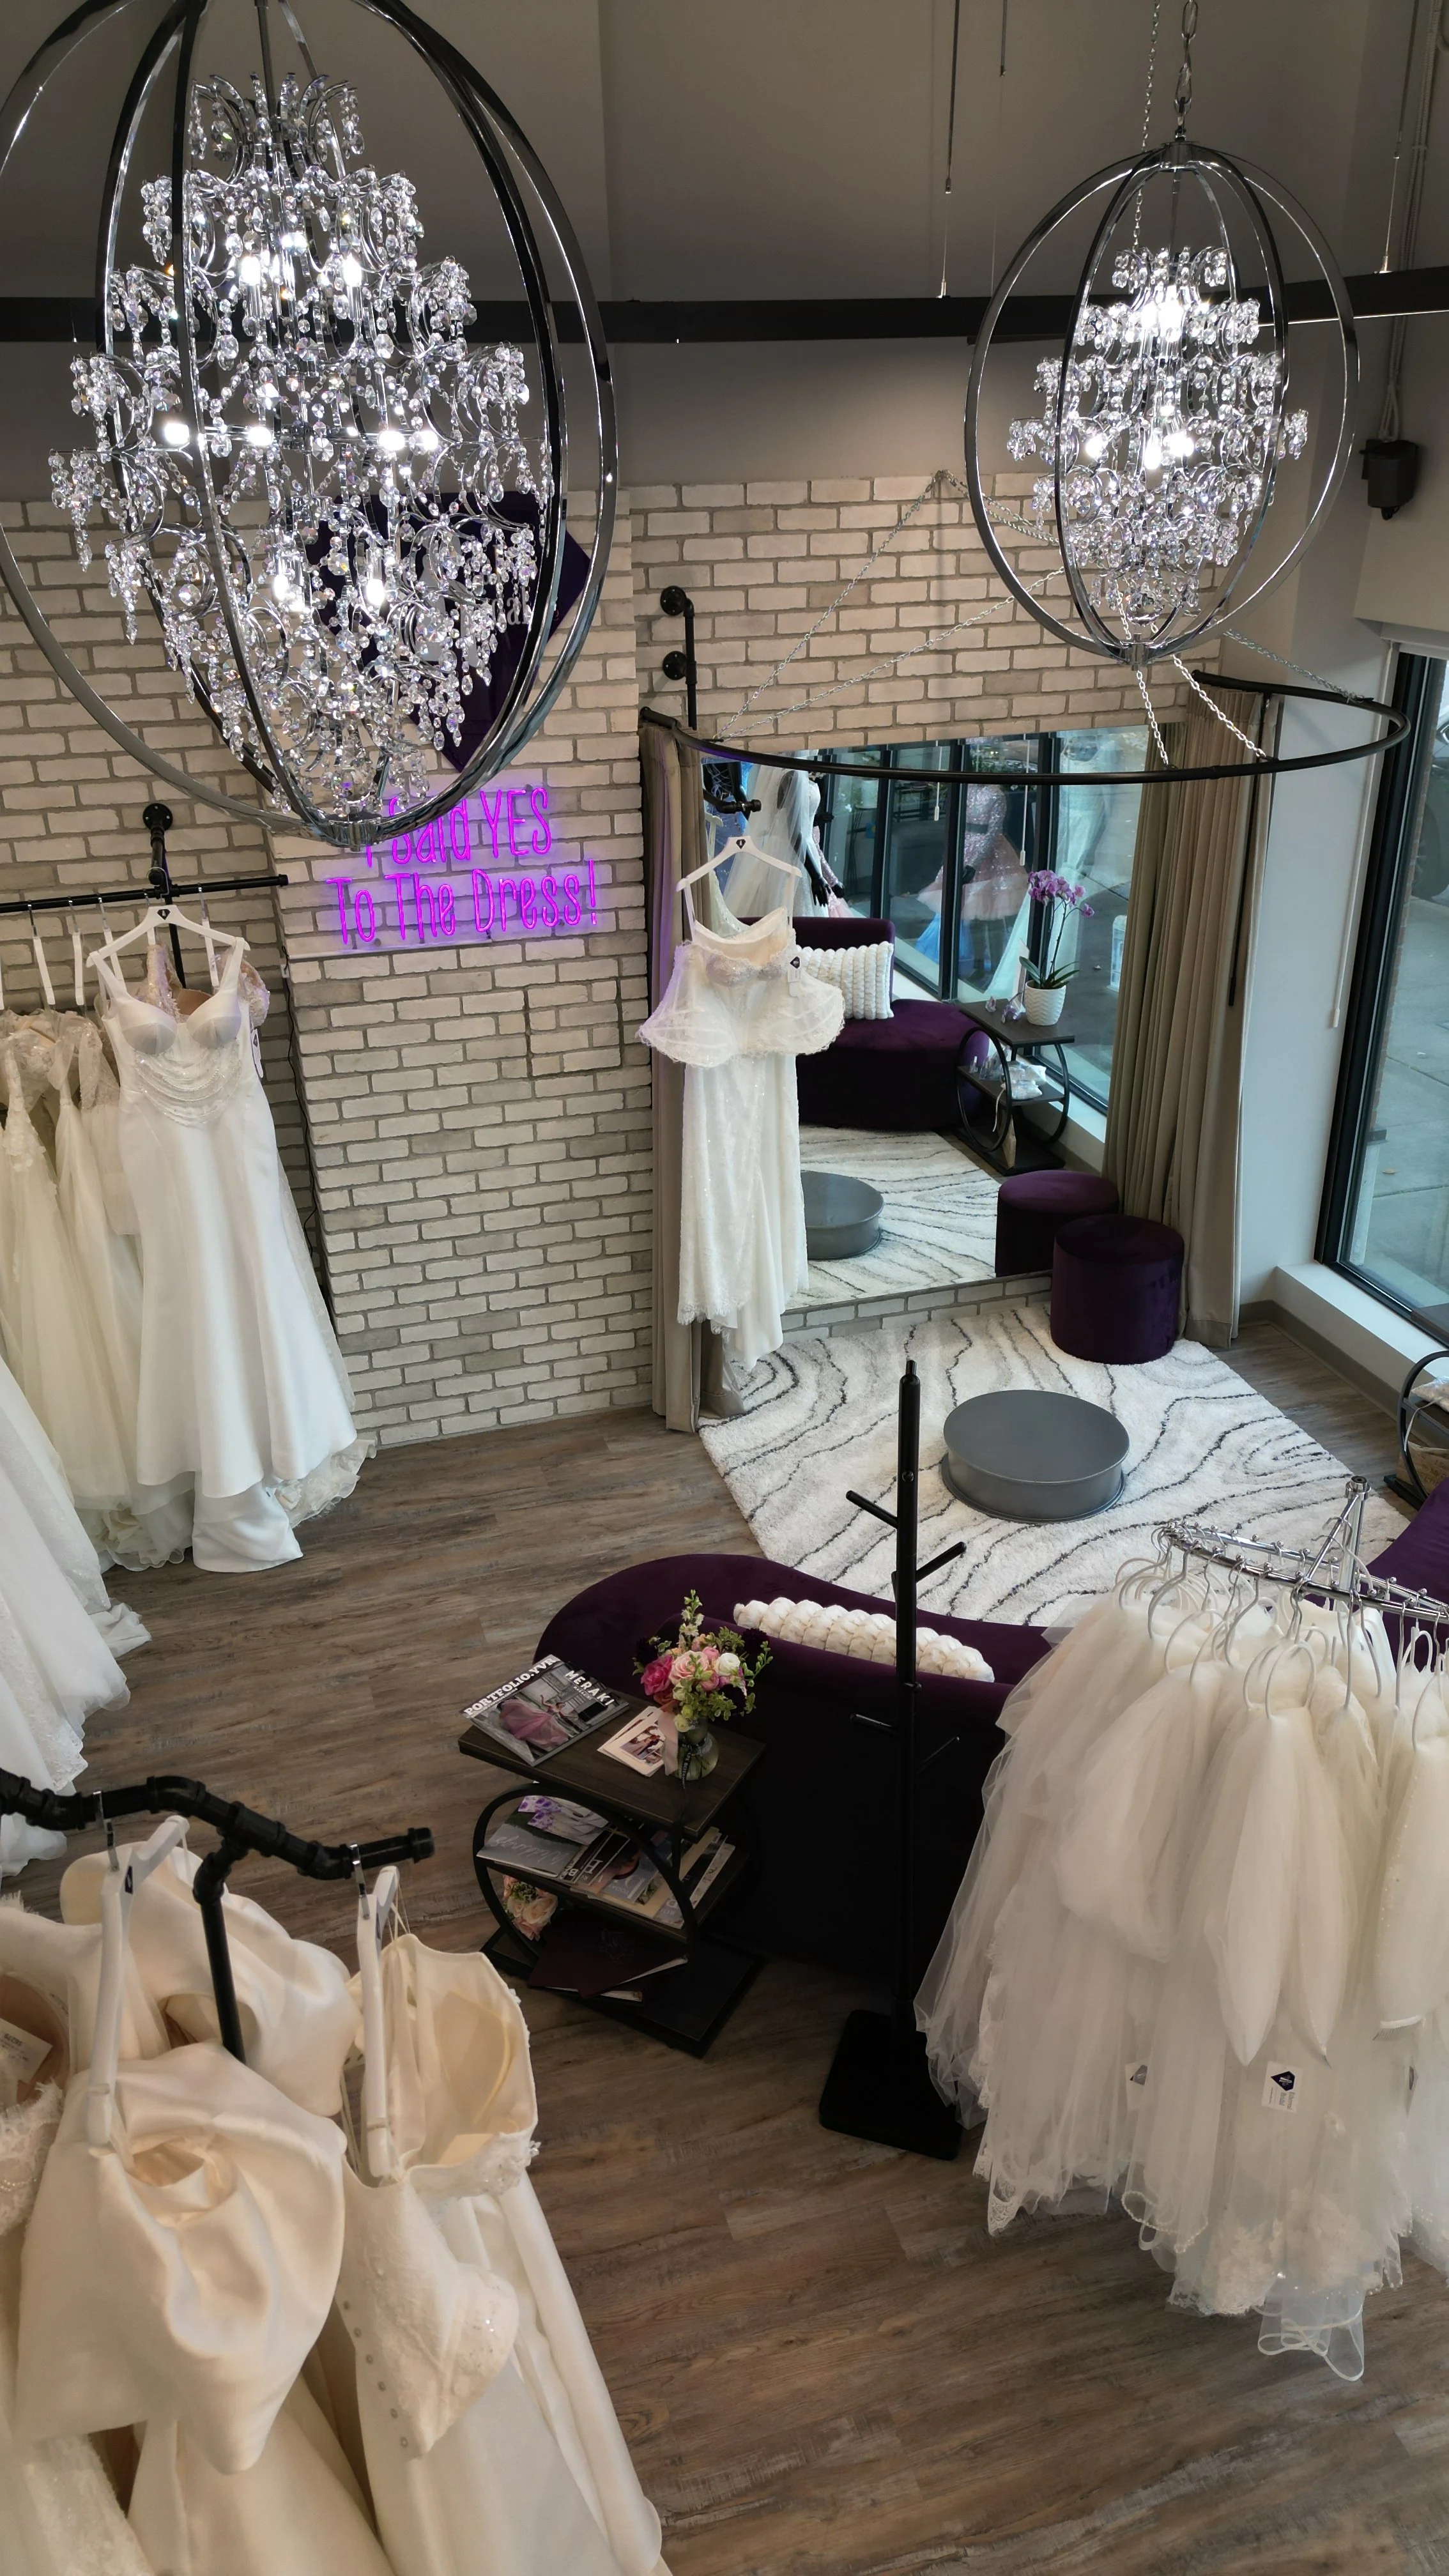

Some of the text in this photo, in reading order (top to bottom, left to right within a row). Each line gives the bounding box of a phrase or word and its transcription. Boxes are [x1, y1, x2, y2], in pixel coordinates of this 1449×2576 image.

[388, 786, 552, 864] Said YES
[325, 859, 597, 945] To The Dress!
[463, 1657, 557, 1716] PORTFOLIO.YVR
[565, 1670, 615, 1706] MERAKI
